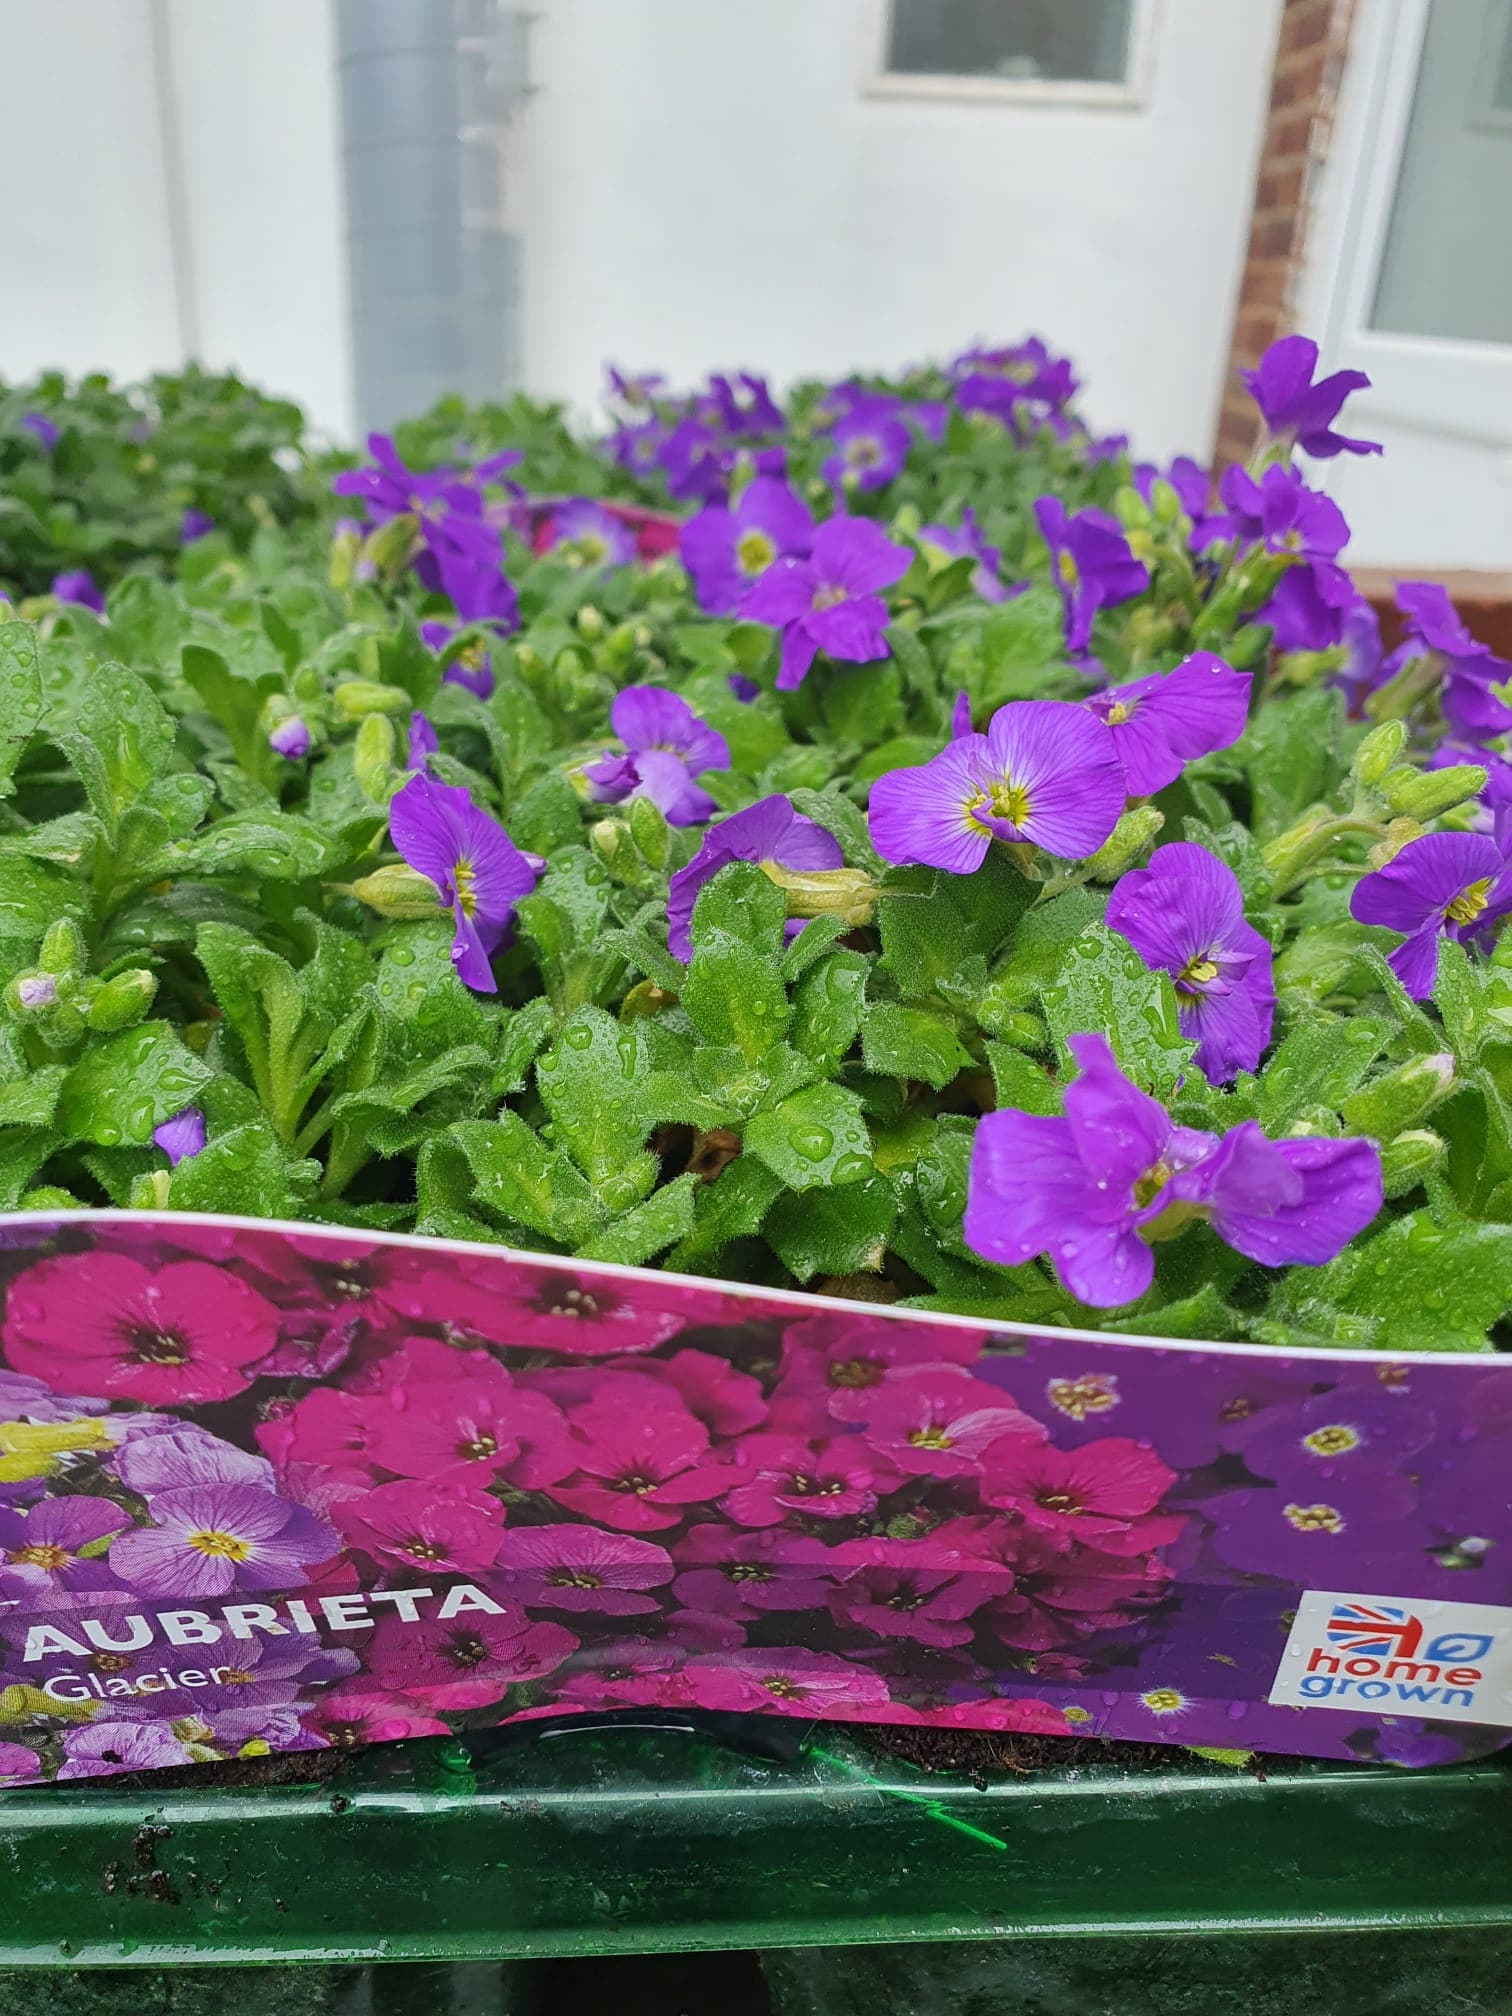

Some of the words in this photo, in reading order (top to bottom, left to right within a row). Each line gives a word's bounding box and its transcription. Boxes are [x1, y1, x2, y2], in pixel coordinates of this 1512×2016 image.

[23, 1584, 506, 1661] AUBRIETA
[43, 1666, 231, 1702] Glacier
[1306, 1648, 1482, 1685] home
[1298, 1676, 1473, 1706] grown
